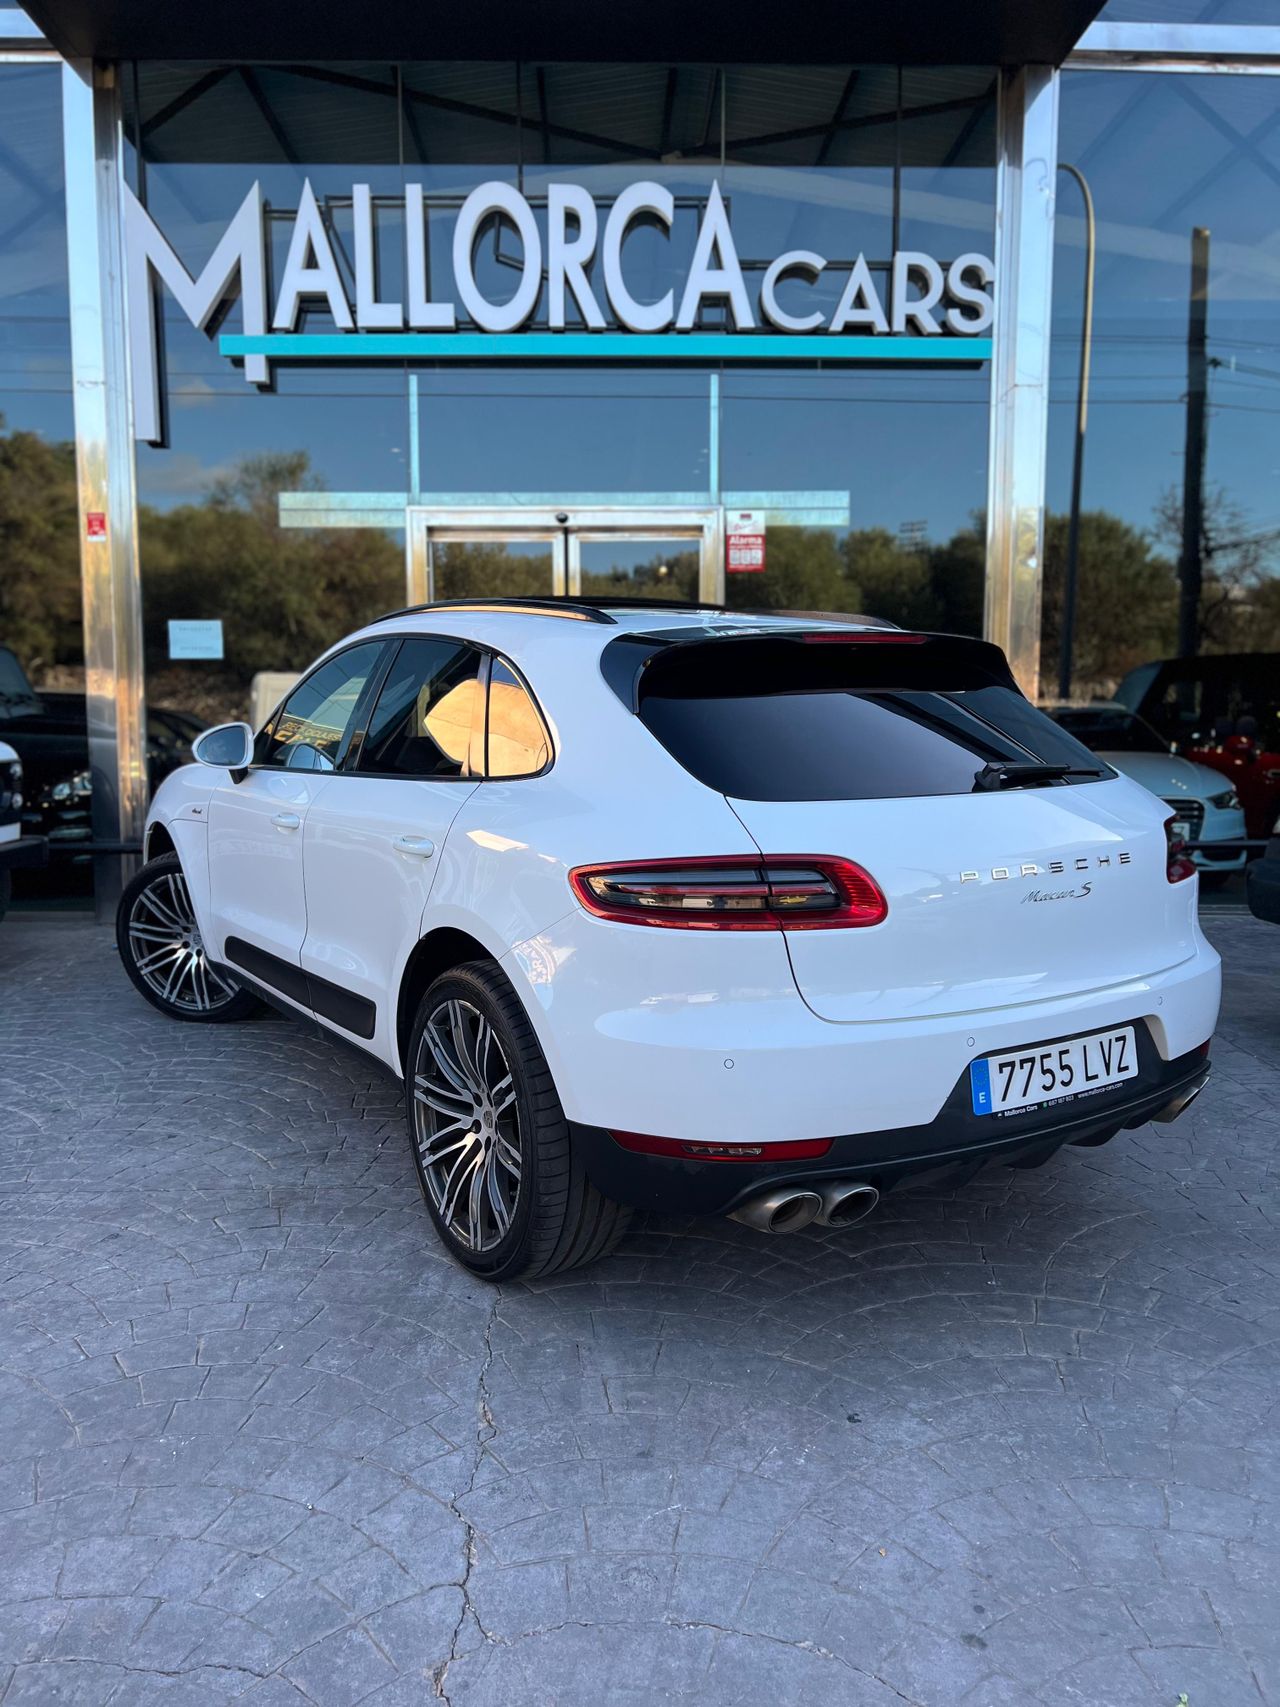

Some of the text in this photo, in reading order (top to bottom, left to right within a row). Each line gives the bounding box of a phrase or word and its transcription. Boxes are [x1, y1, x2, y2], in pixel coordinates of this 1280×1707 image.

[123, 177, 995, 442] MALLORCA CARS
[960, 852, 1132, 884] PORSCHE
[1020, 881, 1093, 905] Macan S
[998, 1034, 1130, 1102] 7755 LVZ
[979, 1092, 986, 1103] E
[1004, 1107, 1026, 1118] Mallorca
[1026, 1104, 1038, 1113] Cars
